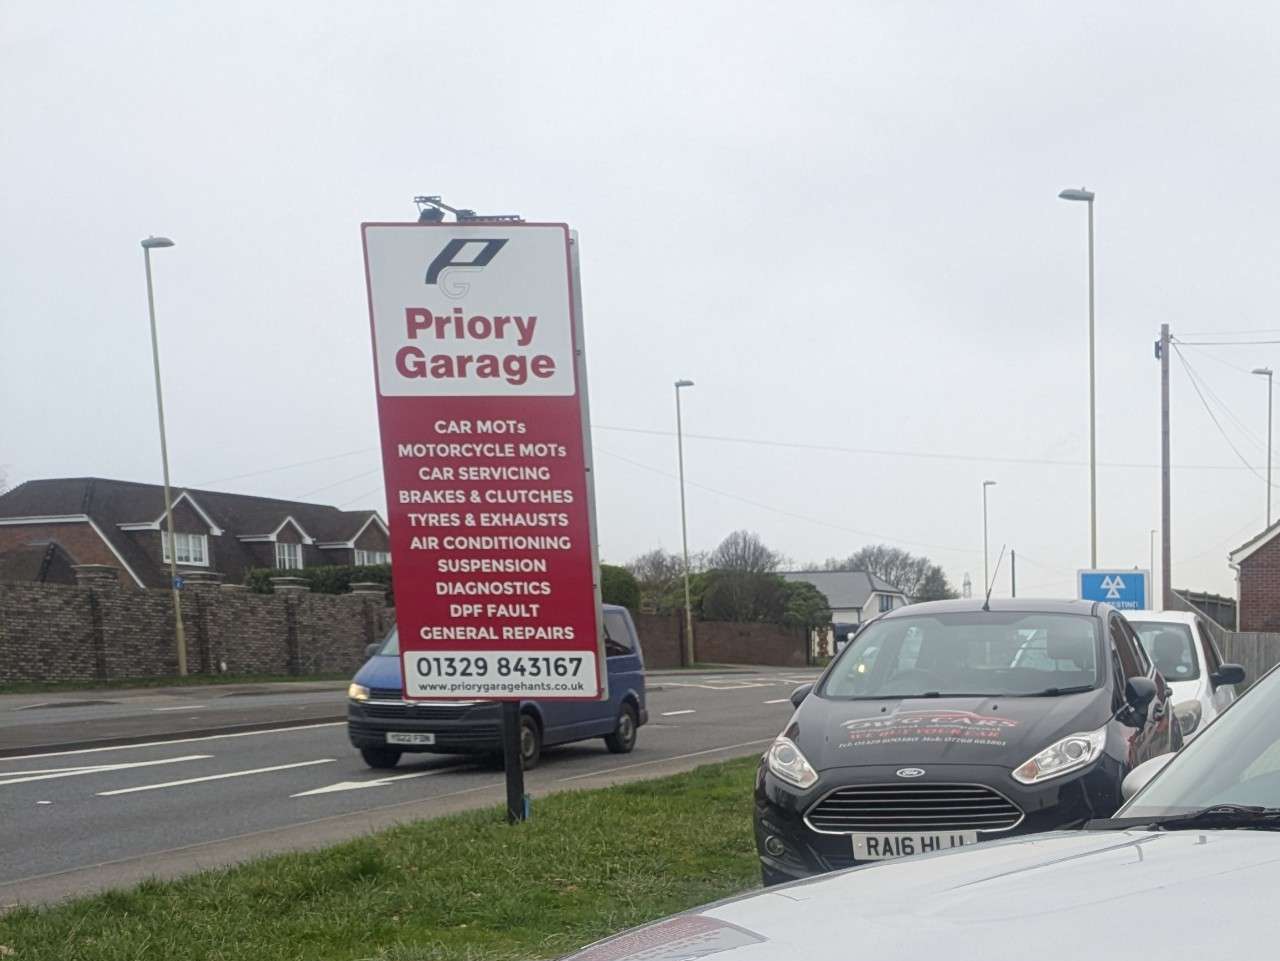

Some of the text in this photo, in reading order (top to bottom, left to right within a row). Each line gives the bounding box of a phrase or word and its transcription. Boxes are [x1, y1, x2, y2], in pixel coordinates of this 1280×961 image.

[404, 307, 538, 346] Priory
[395, 346, 556, 385] Garage
[434, 420, 526, 434] CAR MOTs
[398, 444, 567, 458] MOTORCYCLE MOTs
[419, 467, 550, 480] CAR SERVICING
[399, 490, 573, 503] BRAKES & CLUTCHES
[408, 513, 568, 526] TYRES & EXHAUSTS
[410, 536, 571, 549] AIR CONDITIONING
[437, 559, 546, 573] SUSPENSION
[436, 582, 551, 595] DIAGNOSTICS
[450, 604, 540, 617] DPF FAULT
[420, 627, 574, 640] GENERAL REPAIRS
[416, 657, 583, 677] 01329 843167
[419, 681, 584, 694] www.priorygaragehants.co.uk
[866, 836, 915, 856] RA16
